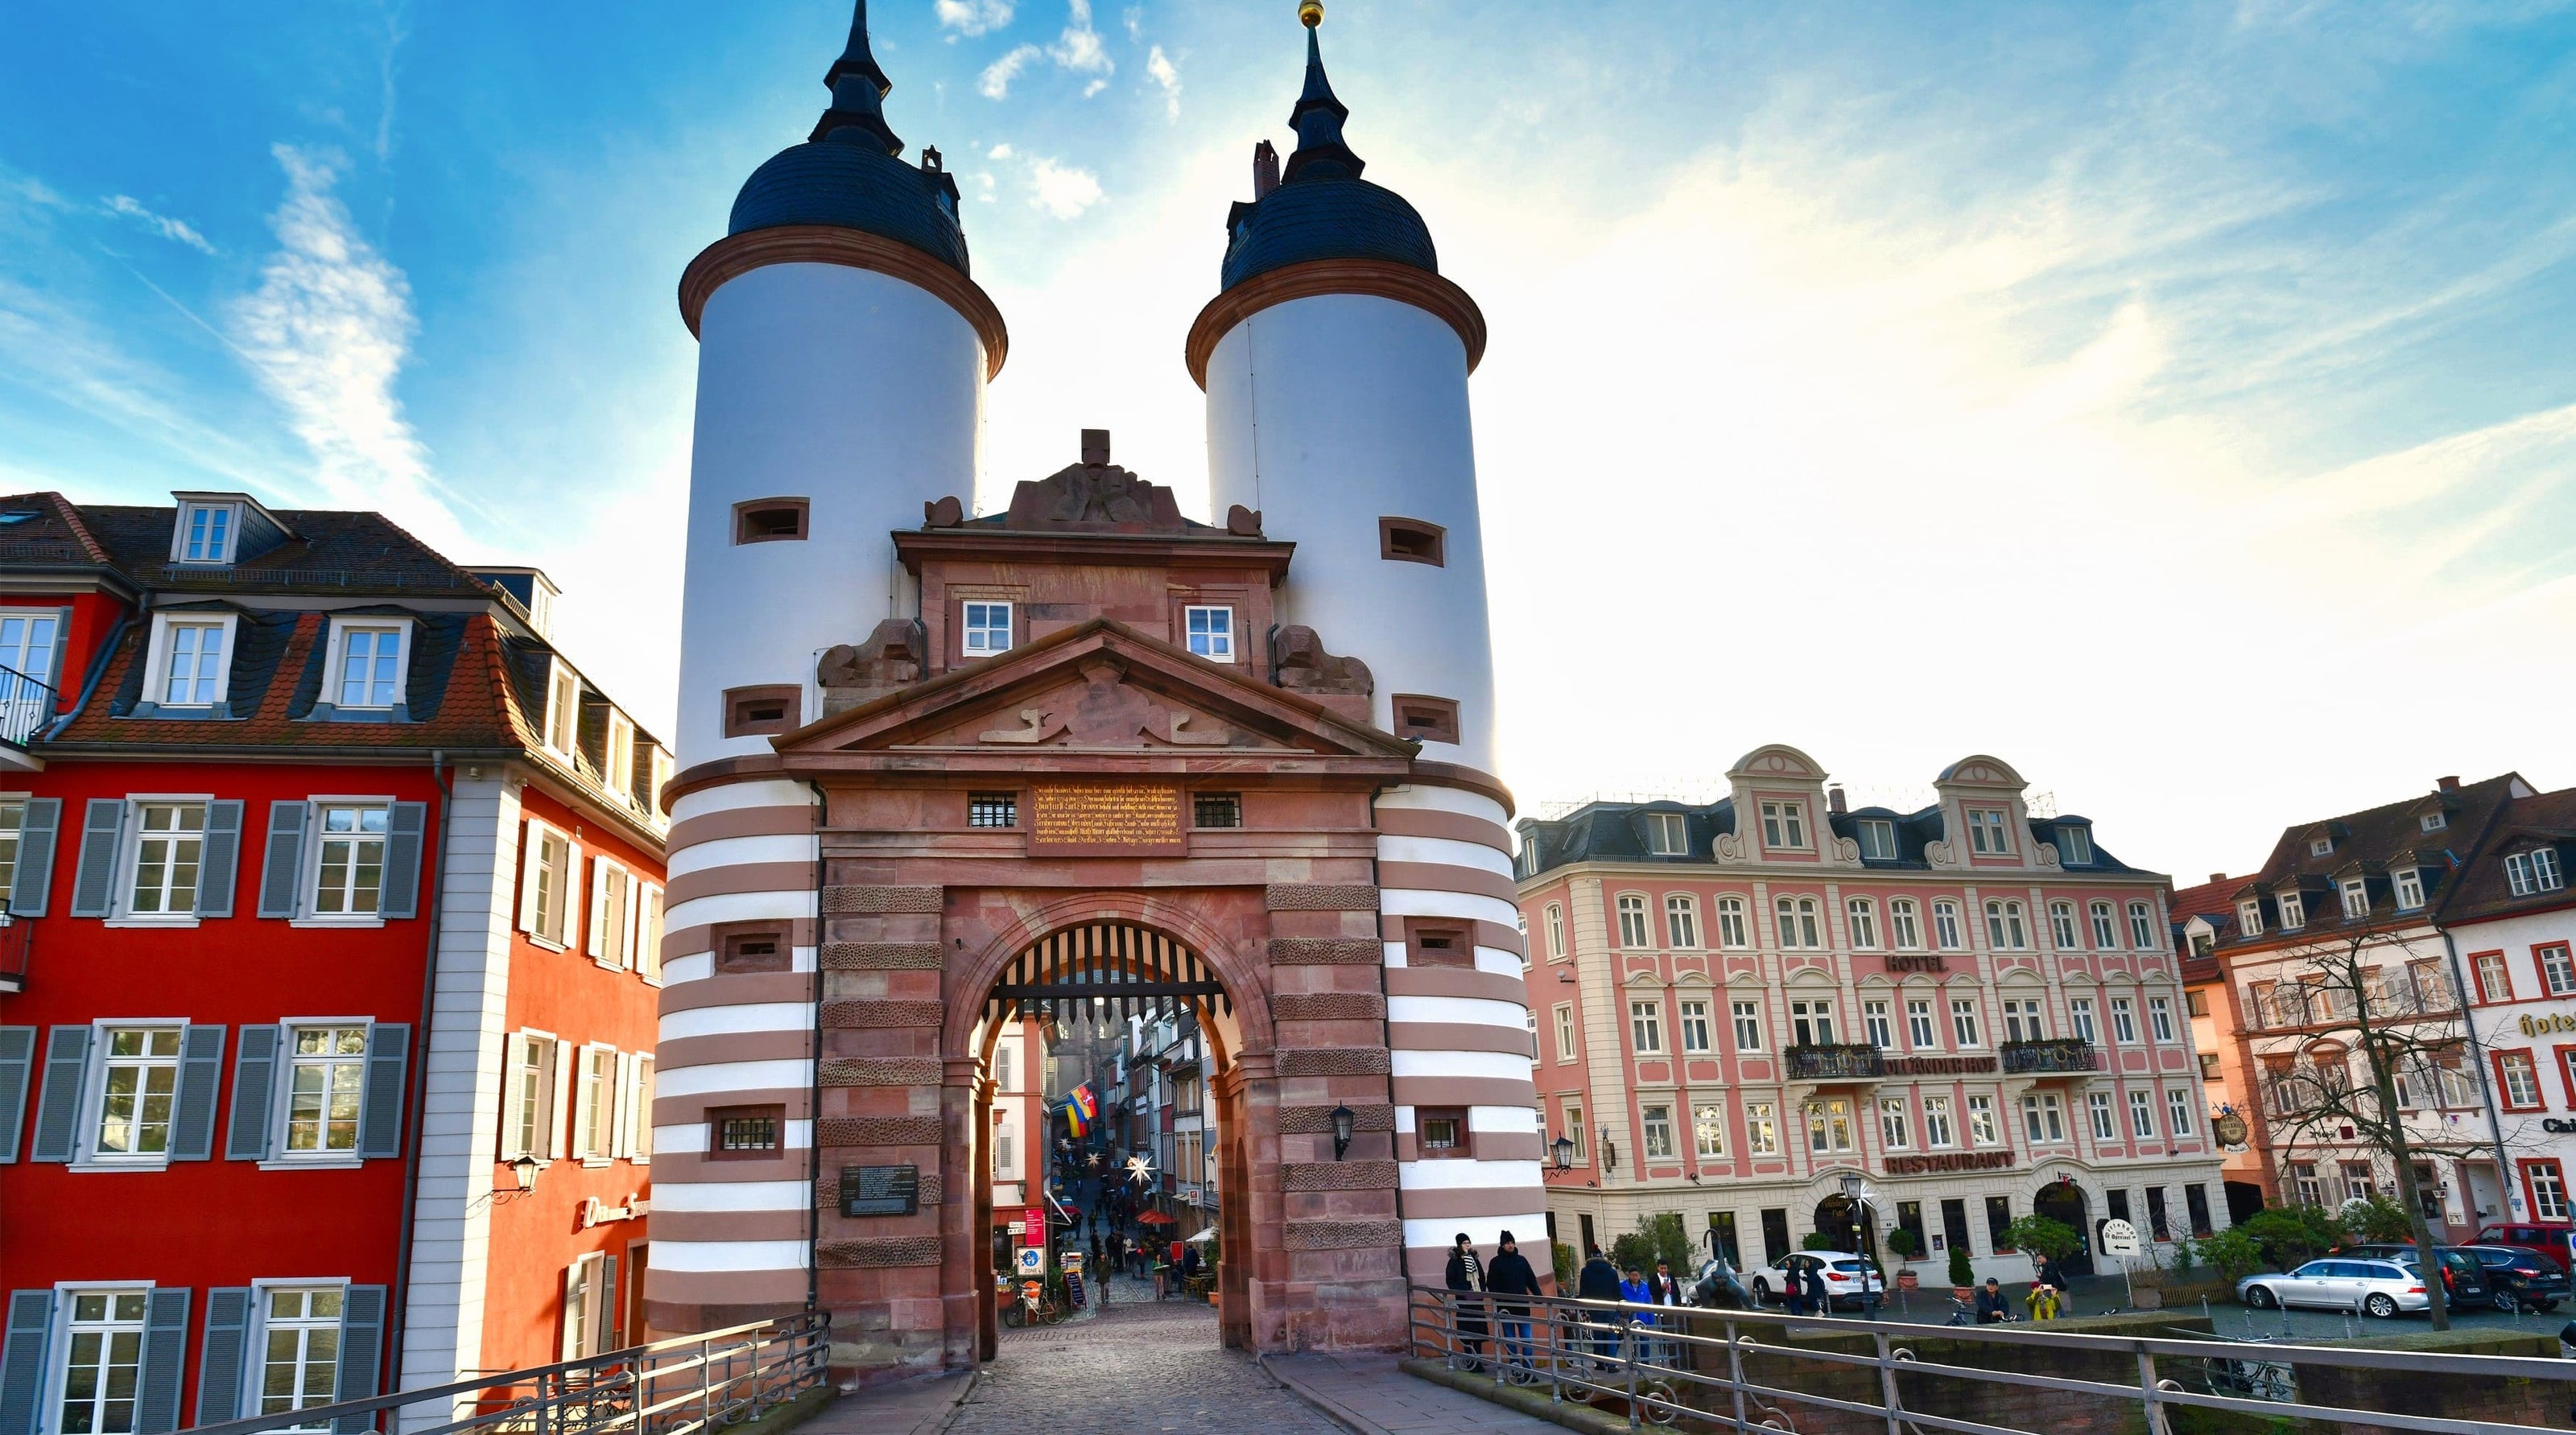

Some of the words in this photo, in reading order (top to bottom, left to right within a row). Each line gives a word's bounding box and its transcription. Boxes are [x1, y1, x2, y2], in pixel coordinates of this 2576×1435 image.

[1885, 955, 1949, 972] HOTEL
[2519, 1011, 2576, 1038] Hote
[1883, 1056, 1965, 1075] OLLÄNDER
[1966, 1056, 1998, 1074] HOF
[1884, 1150, 2017, 1174] RESTAURANT
